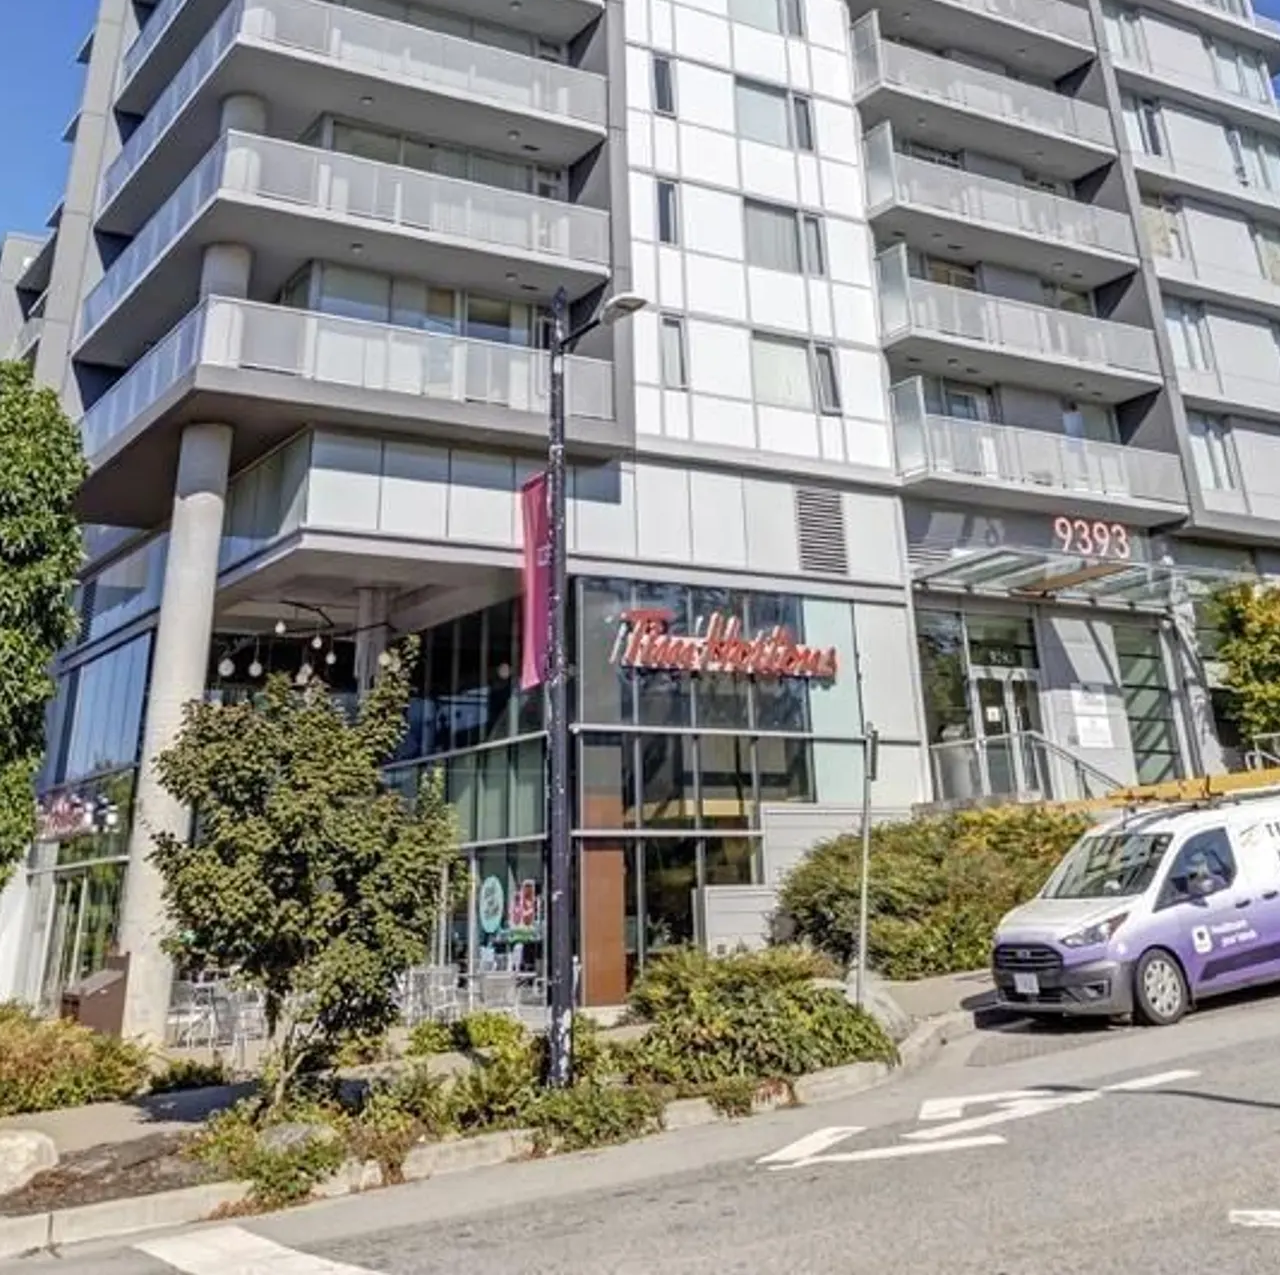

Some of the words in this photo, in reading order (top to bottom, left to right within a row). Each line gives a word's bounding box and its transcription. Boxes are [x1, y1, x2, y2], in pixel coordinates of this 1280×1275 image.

[1055, 516, 1131, 559] 9393
[608, 608, 697, 669] Tim
[694, 611, 838, 677] Hortons
